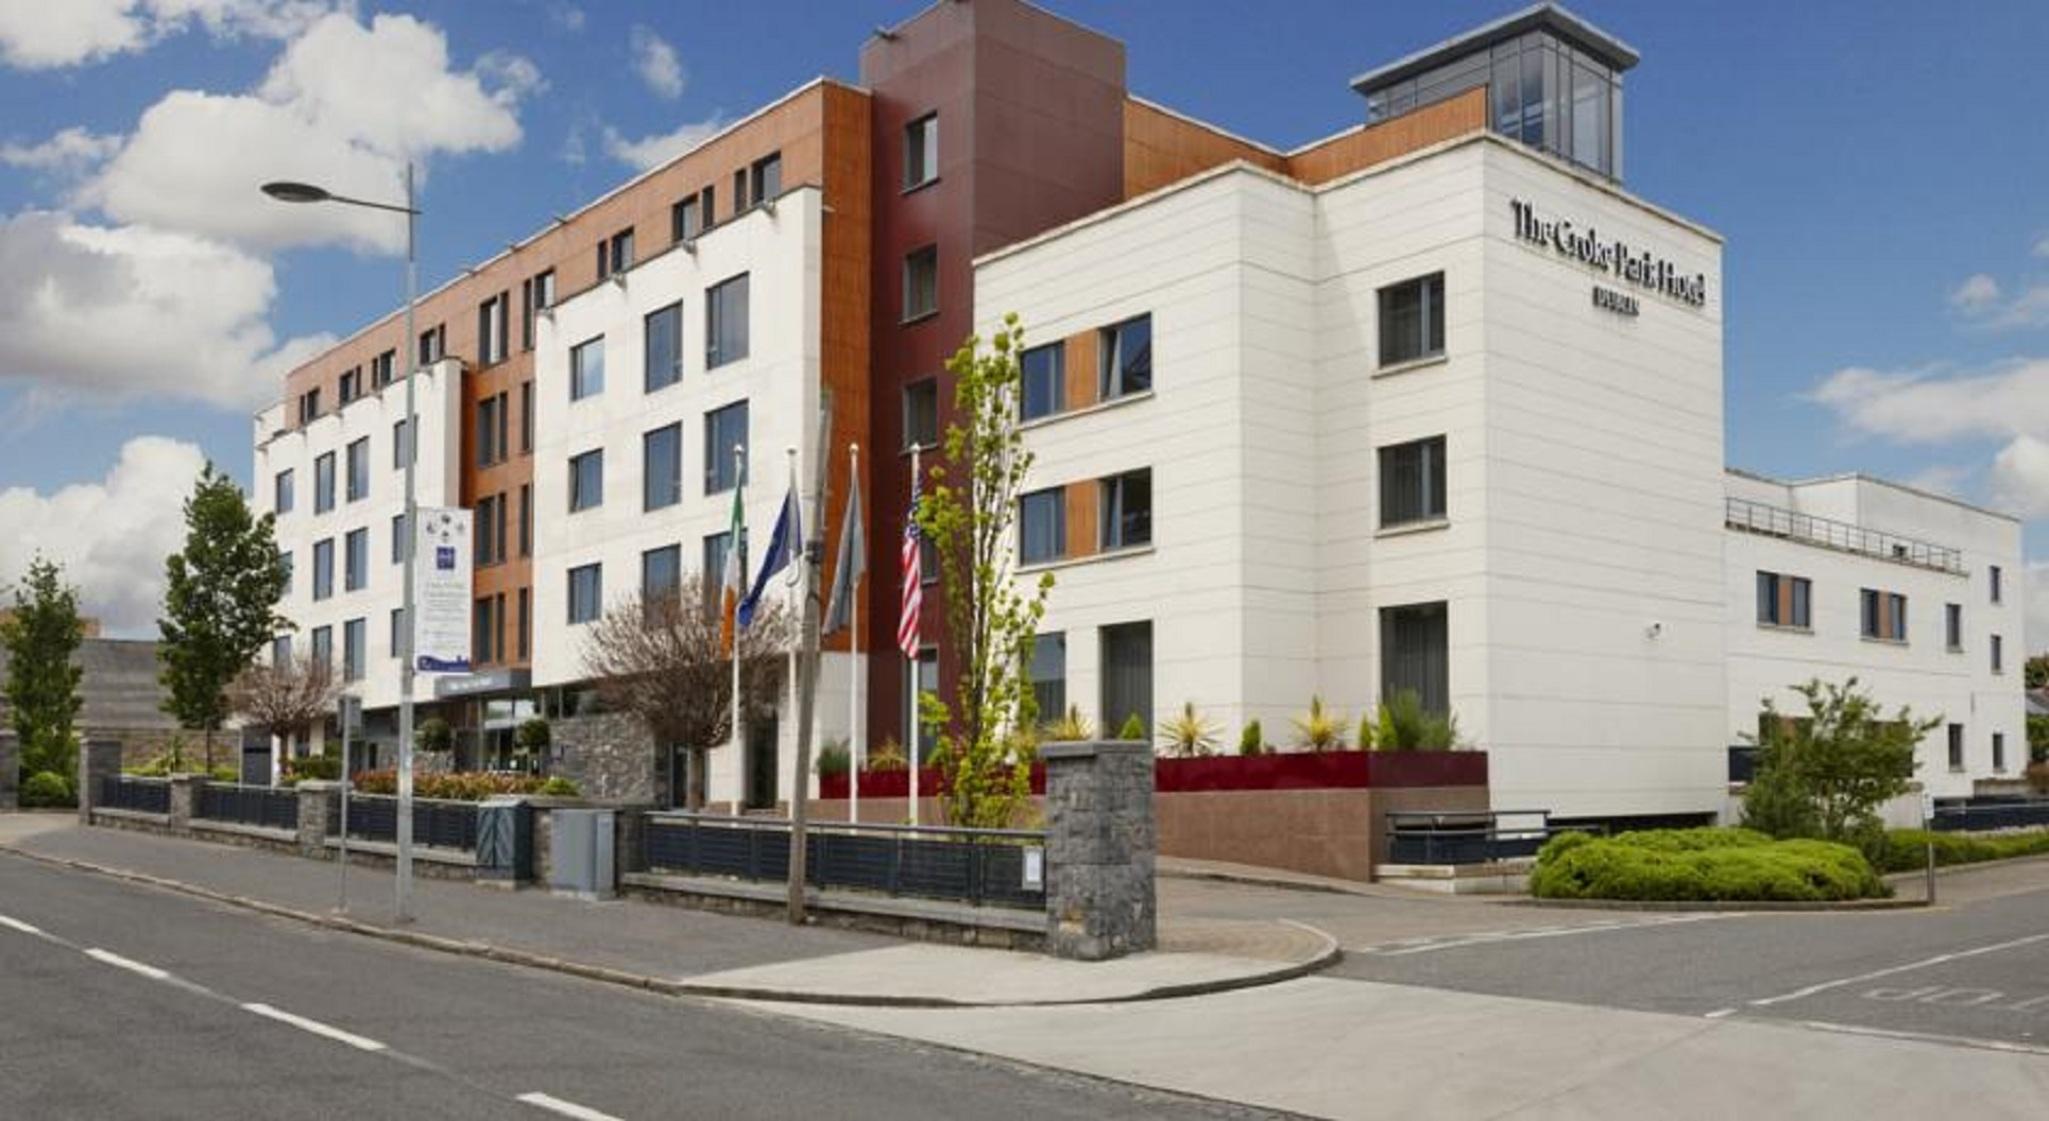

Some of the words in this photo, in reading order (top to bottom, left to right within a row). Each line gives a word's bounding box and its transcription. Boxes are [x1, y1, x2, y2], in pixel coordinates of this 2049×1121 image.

[1510, 199, 1551, 246] The
[1552, 218, 1612, 273] Croke
[1613, 242, 1657, 289] Park
[1657, 259, 1705, 307] Hotel
